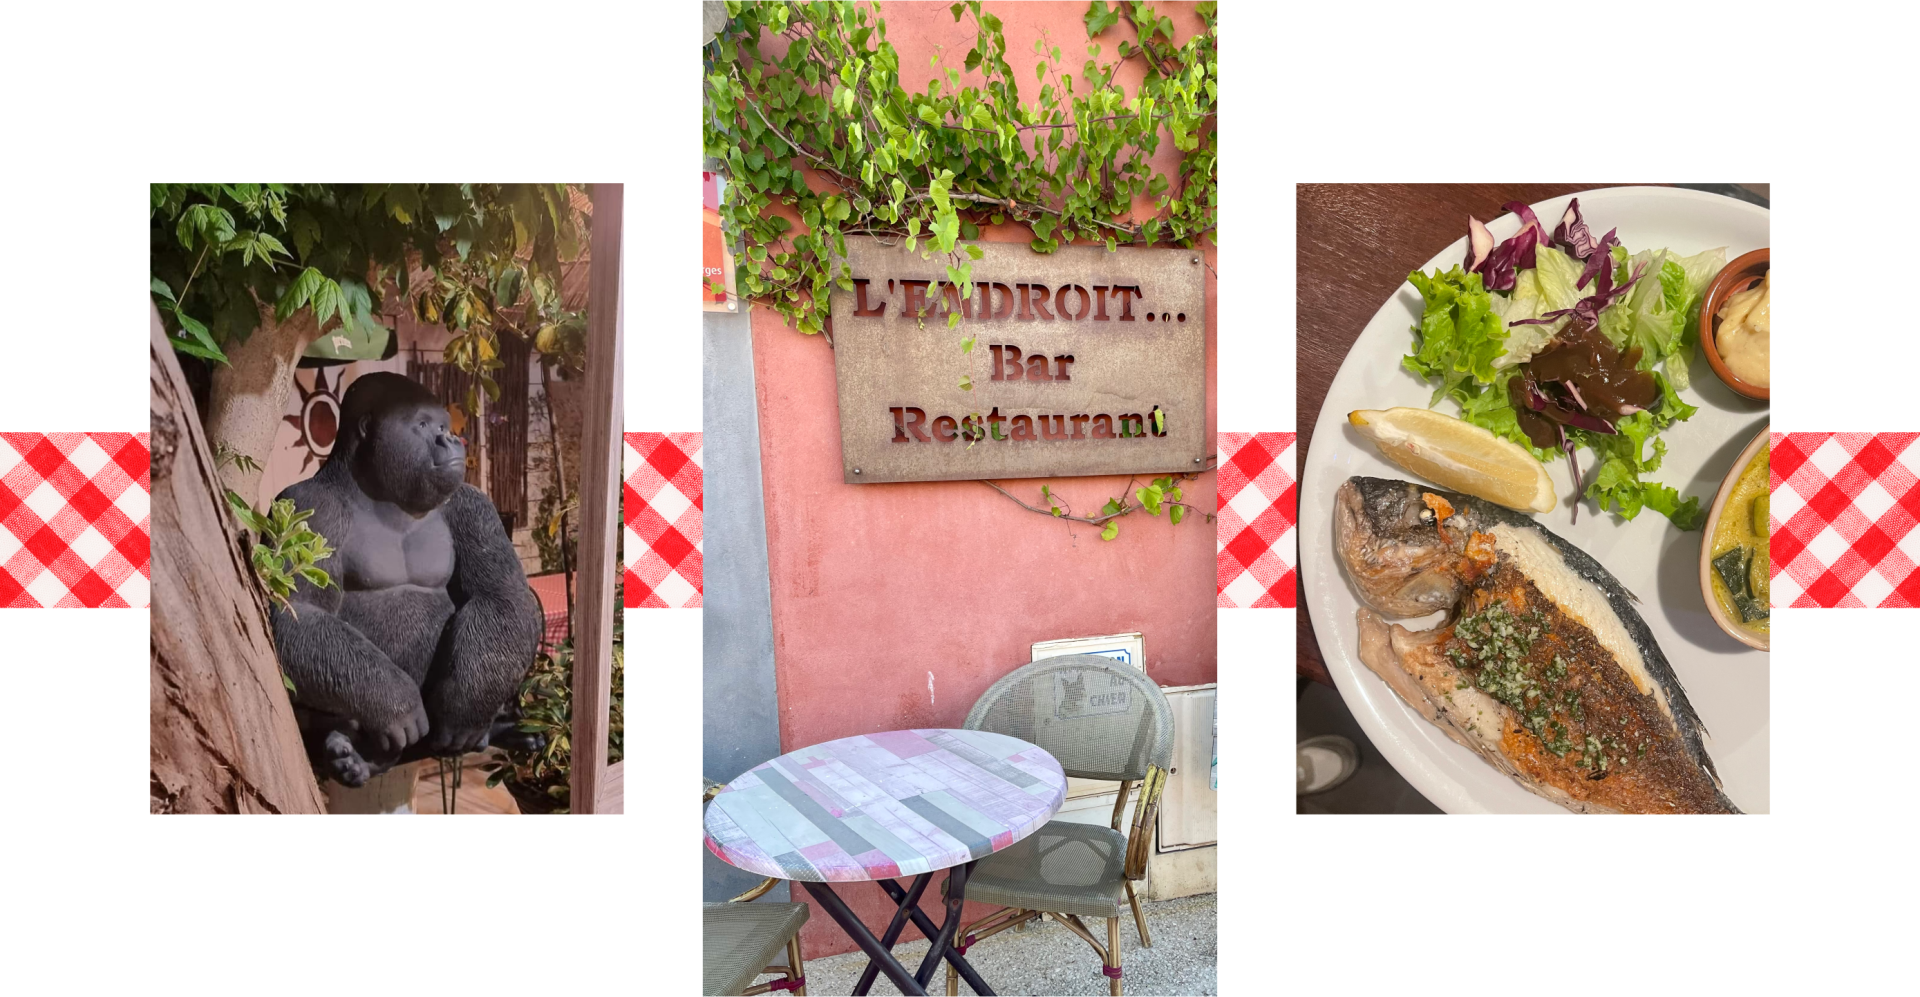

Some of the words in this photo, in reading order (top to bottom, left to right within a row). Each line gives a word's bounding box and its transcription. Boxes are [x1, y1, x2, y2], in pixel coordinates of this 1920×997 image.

[853, 278, 1187, 323] L'ENDROIT...
[989, 344, 1075, 382] Bar
[889, 405, 1168, 443] Restaurant
